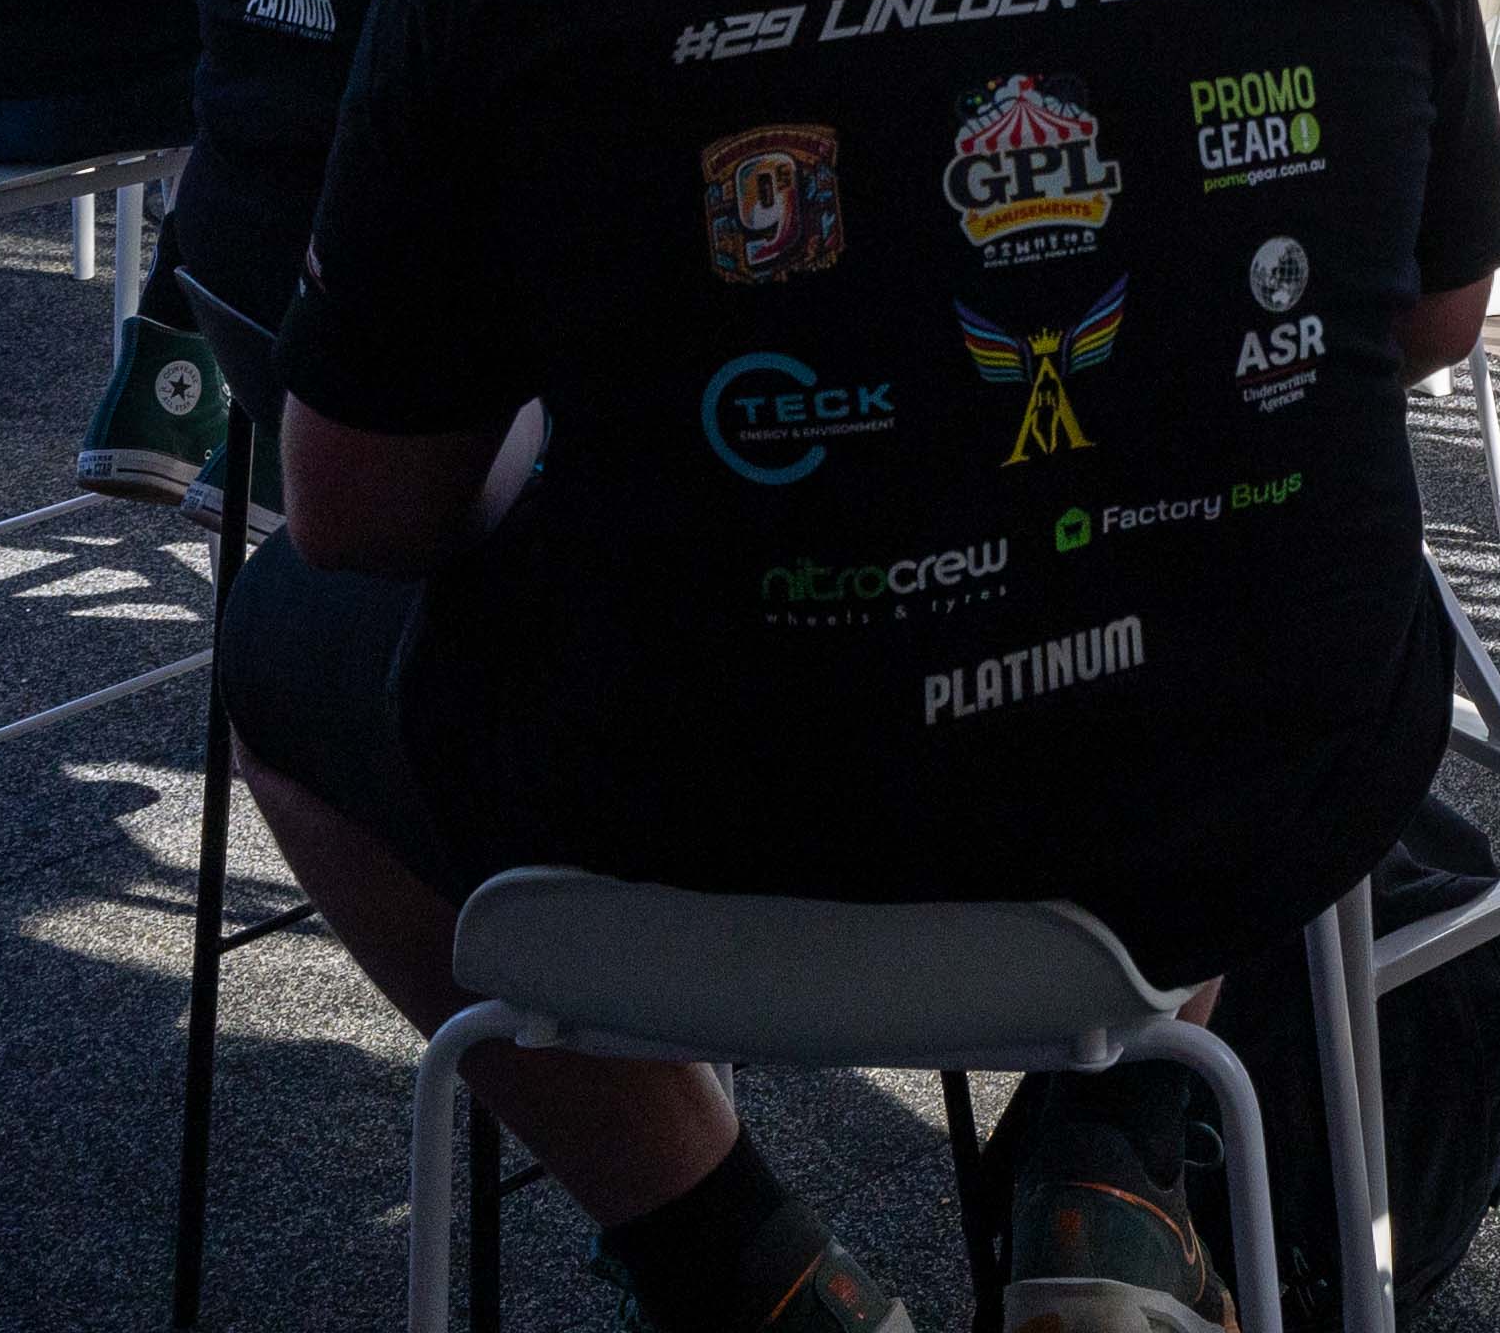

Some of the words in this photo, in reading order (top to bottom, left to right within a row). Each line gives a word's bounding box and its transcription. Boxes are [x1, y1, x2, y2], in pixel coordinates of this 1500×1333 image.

[672, 5, 805, 65] #29
[1189, 65, 1316, 127] PROMO
[948, 140, 1116, 209] GPL
[1203, 158, 1327, 195] promogear.com.au
[983, 200, 1094, 234] AMUSEMENTS
[1236, 314, 1326, 377] ASR
[734, 383, 896, 422] TECK
[739, 426, 789, 441] ENERGY
[802, 417, 896, 438] ENVIRONMENT
[1102, 492, 1222, 534] Factory
[1230, 470, 1303, 510] Buys
[760, 536, 1009, 604] nitrocrew
[765, 610, 871, 629] wheels
[923, 613, 1147, 726] PLATINUM
